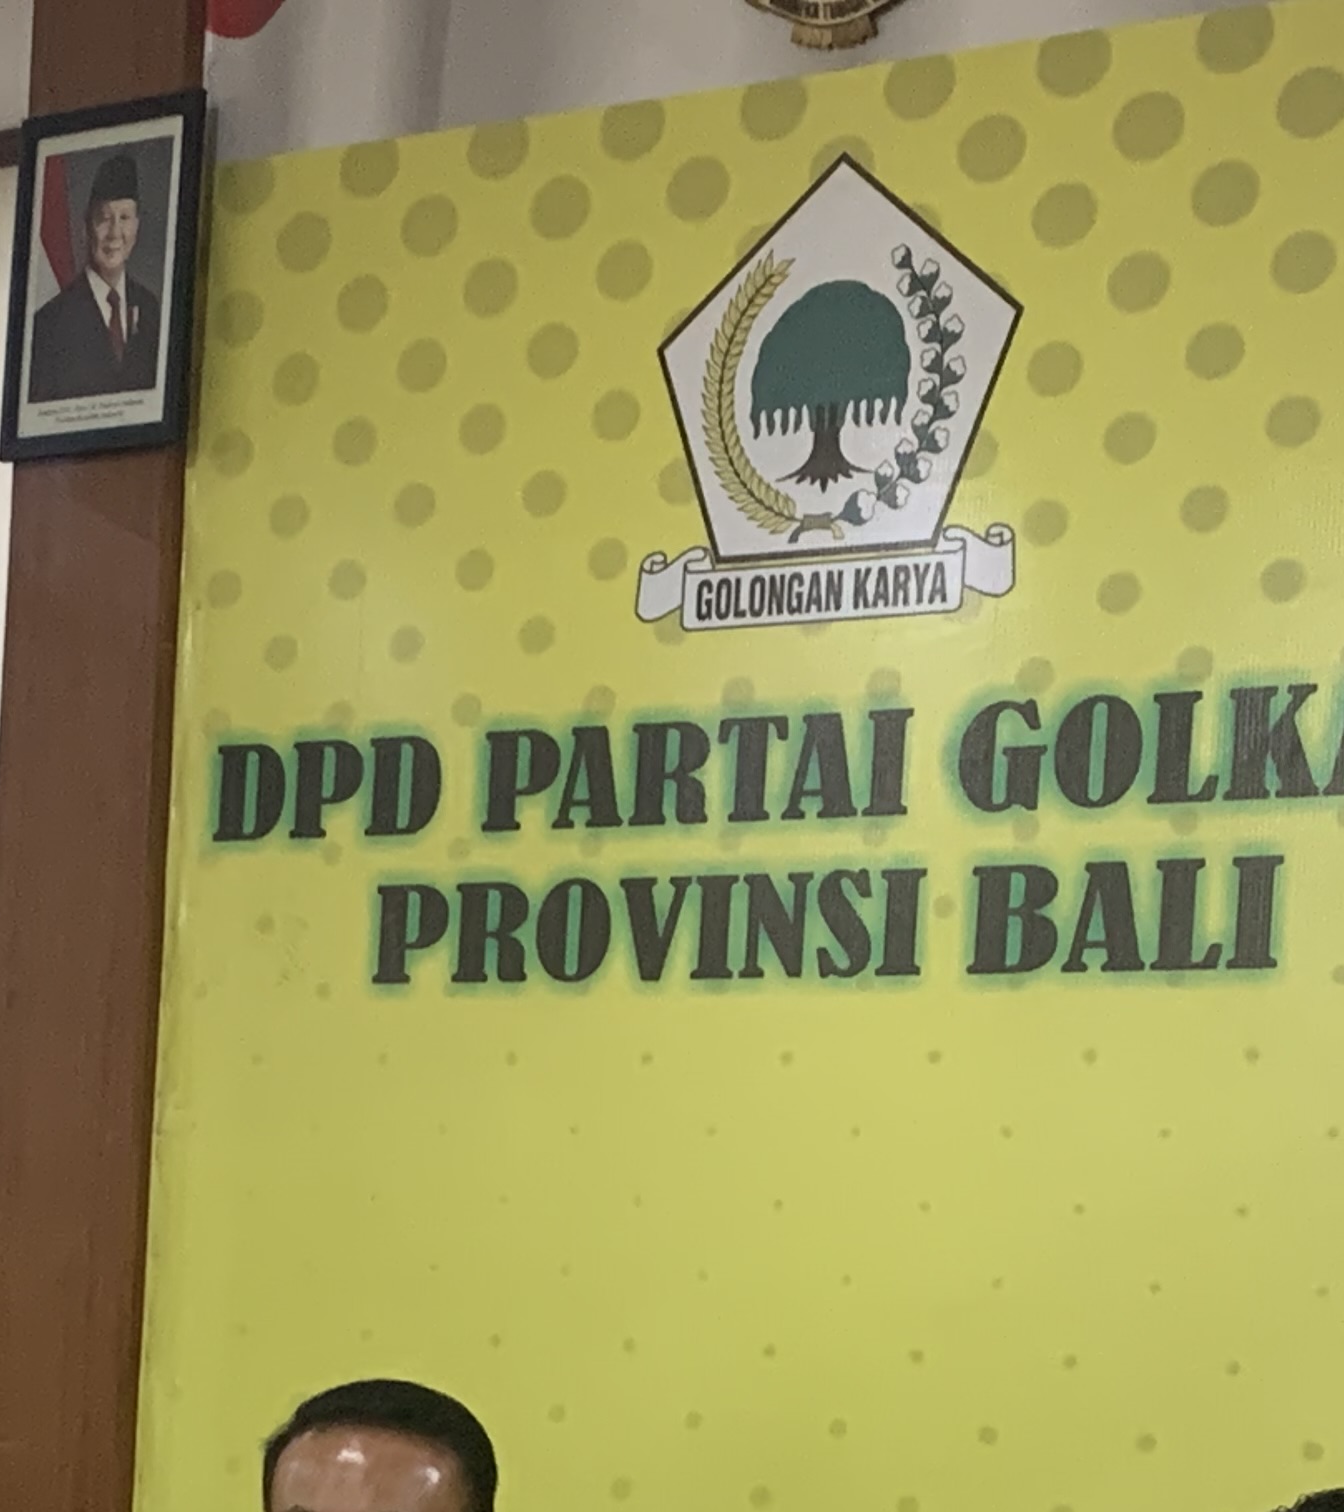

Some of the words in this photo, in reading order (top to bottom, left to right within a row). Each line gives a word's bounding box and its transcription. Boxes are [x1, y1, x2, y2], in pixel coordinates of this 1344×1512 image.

[695, 569, 844, 622] GOLONGAN
[853, 561, 948, 611] KARYA
[212, 735, 442, 842] DPD
[481, 707, 915, 833] PARTAI
[371, 868, 927, 984] PROVINSI
[966, 855, 1284, 974] BALI
